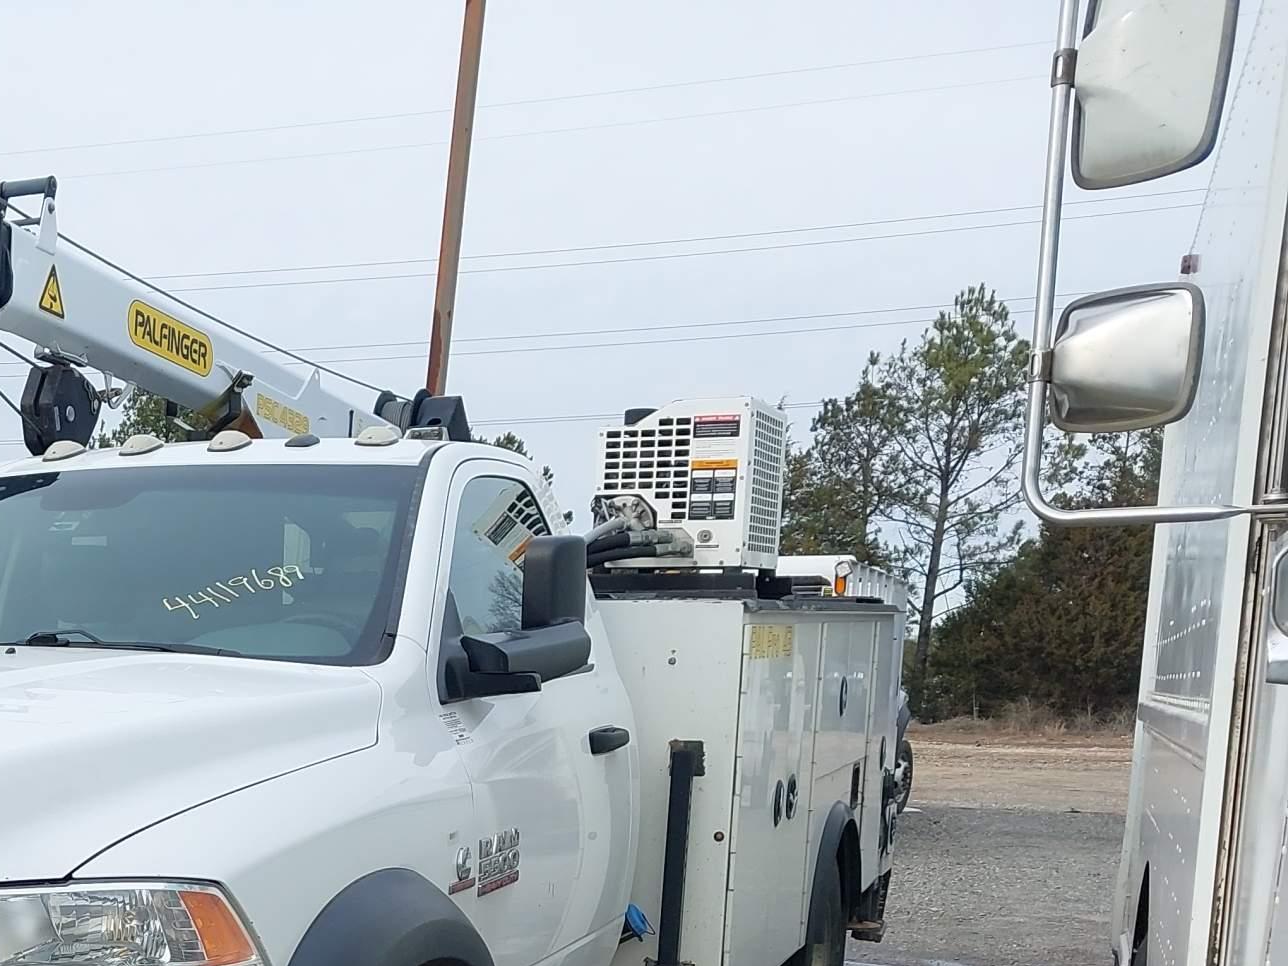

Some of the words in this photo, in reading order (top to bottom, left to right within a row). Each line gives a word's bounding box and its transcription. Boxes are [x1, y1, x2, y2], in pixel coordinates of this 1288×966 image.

[134, 308, 208, 369] PALFINGER
[162, 564, 305, 620] 44119689
[478, 827, 520, 861] RAM
[478, 848, 520, 882] 5500
